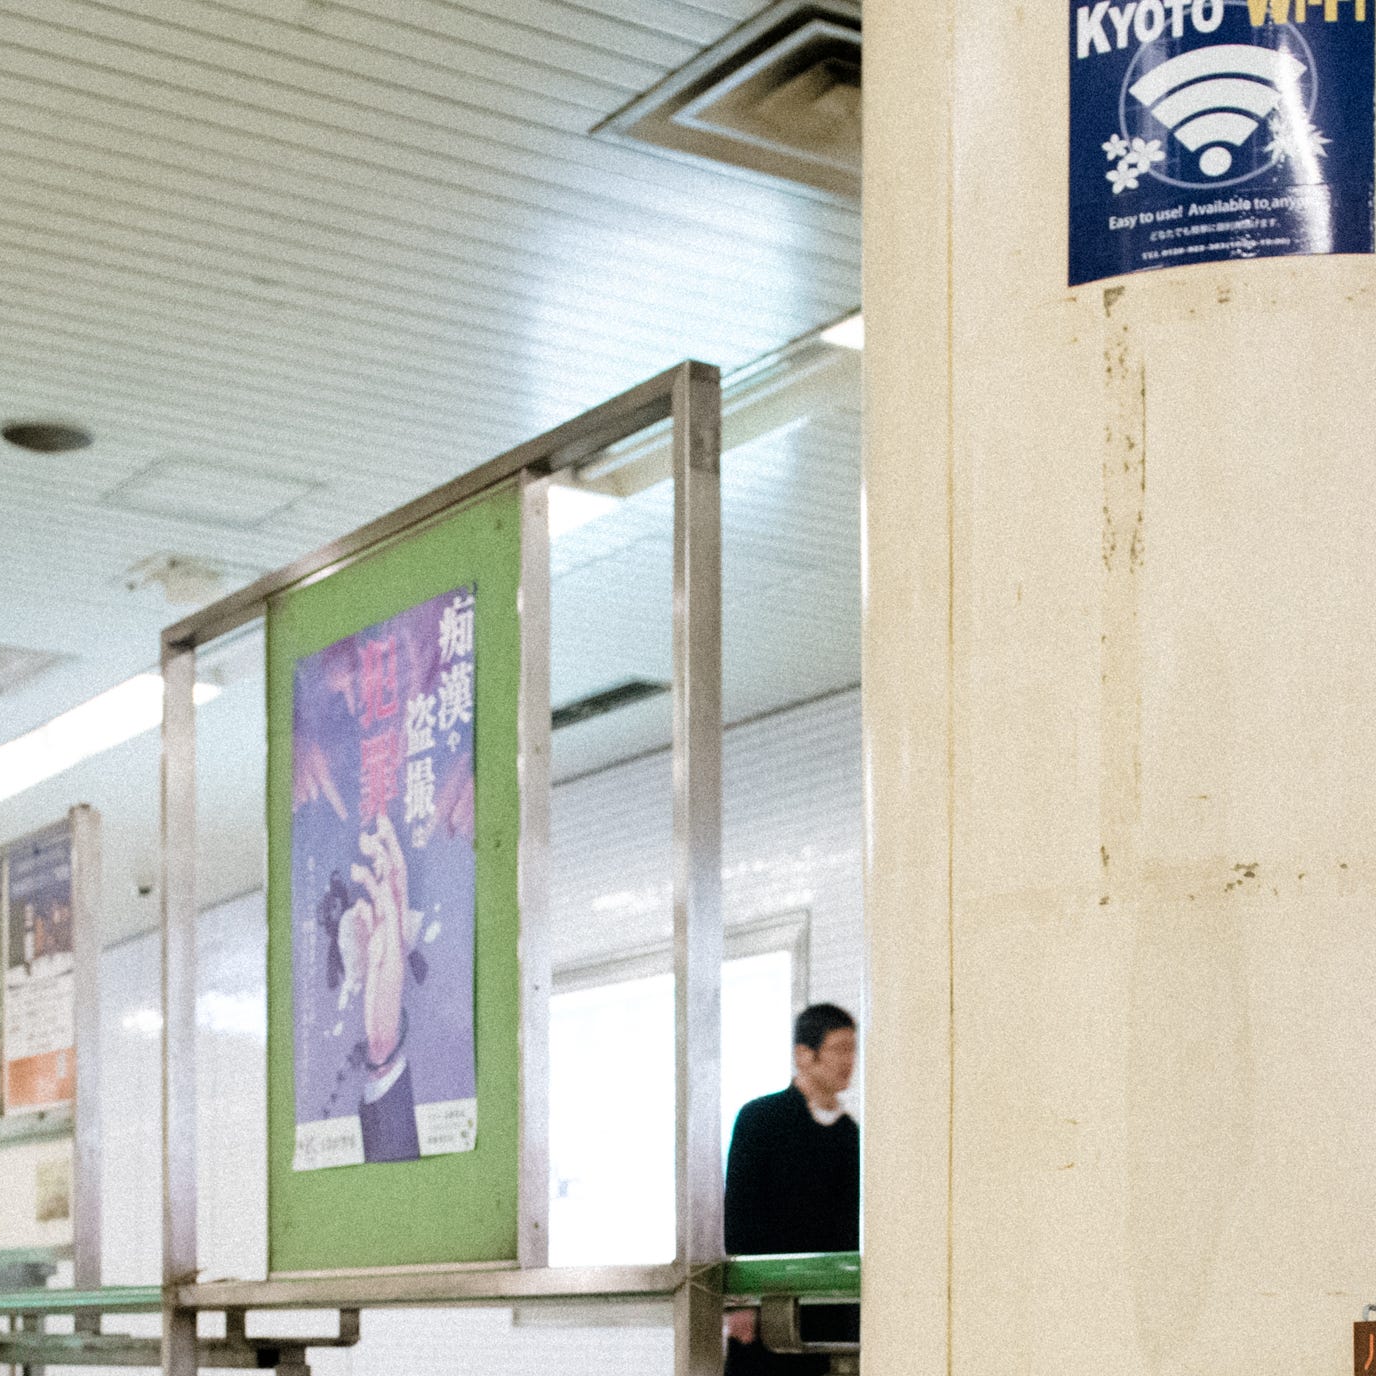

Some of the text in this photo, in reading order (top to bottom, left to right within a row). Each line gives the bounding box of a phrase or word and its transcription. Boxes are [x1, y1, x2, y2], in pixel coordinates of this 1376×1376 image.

[1077, 0, 1224, 59] KYOTO
[1109, 214, 1137, 230] Easy
[1139, 211, 1154, 224] to
[1156, 206, 1183, 219] use!
[1188, 198, 1252, 216] Available
[1254, 198, 1269, 210] to
